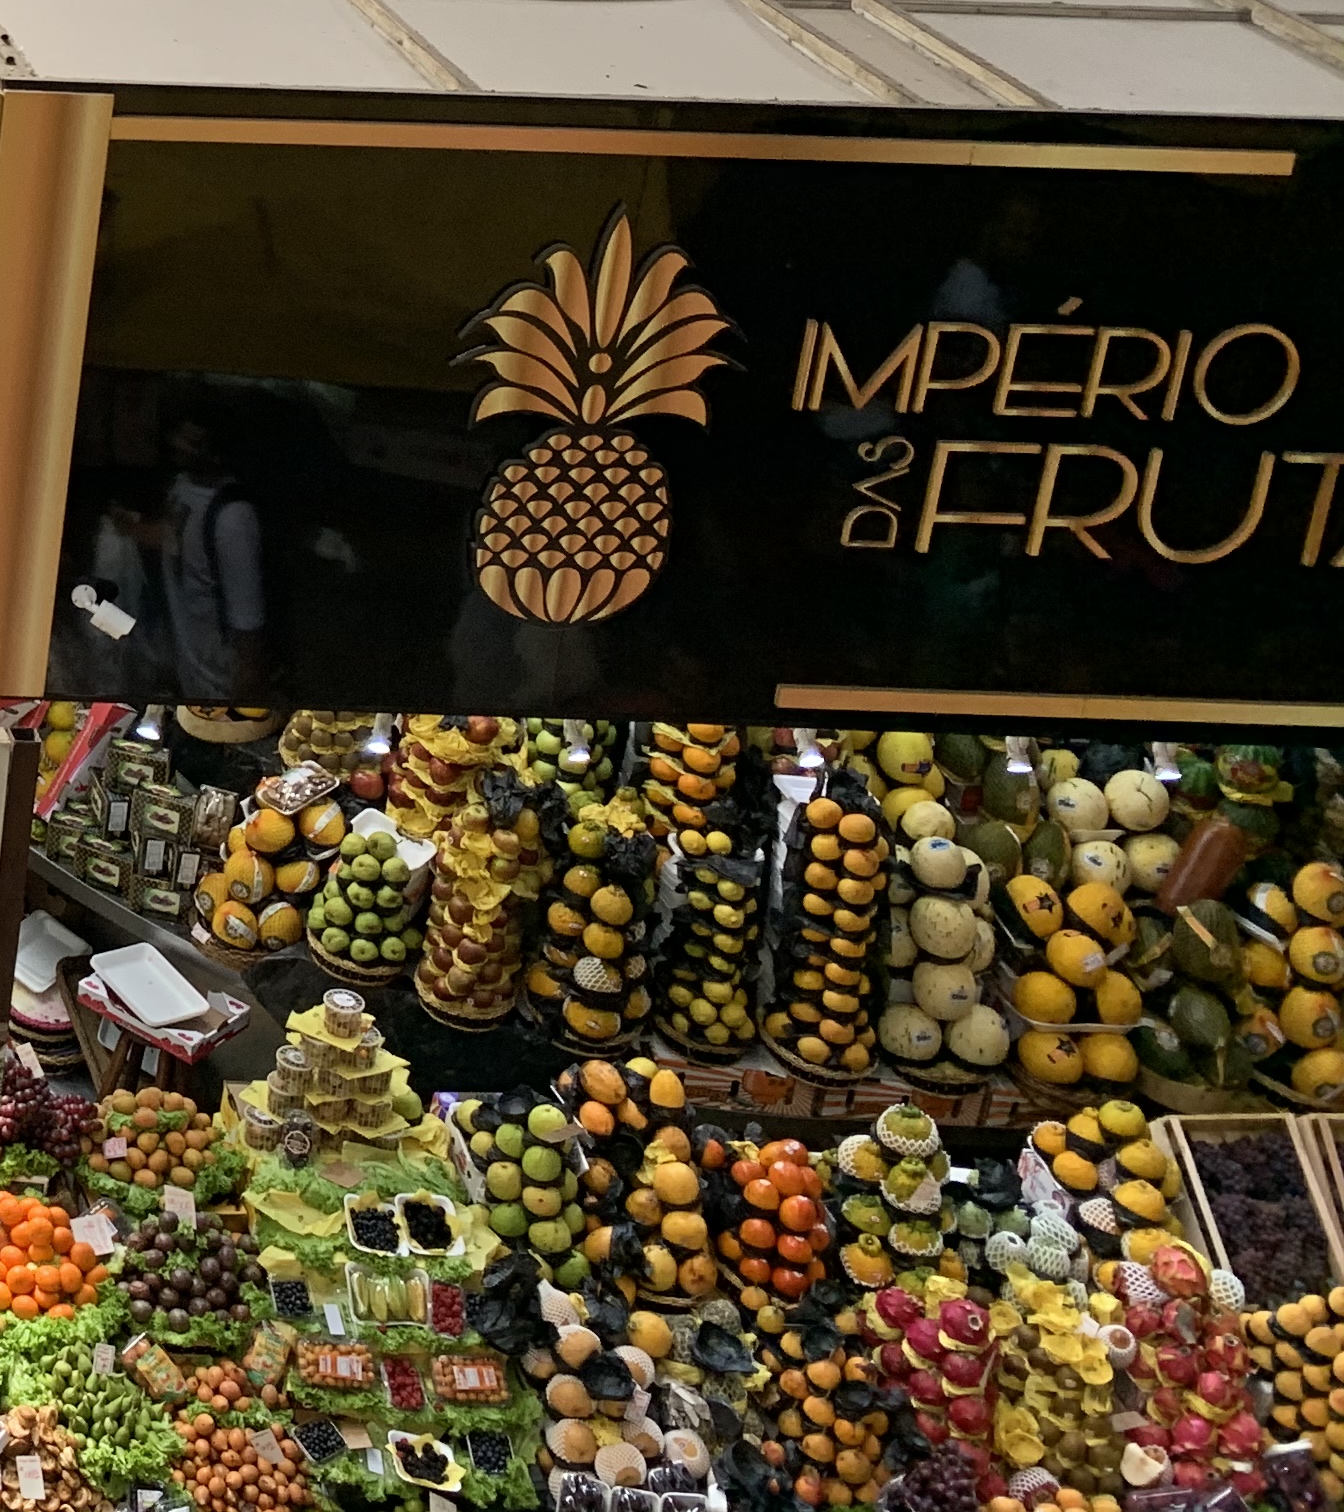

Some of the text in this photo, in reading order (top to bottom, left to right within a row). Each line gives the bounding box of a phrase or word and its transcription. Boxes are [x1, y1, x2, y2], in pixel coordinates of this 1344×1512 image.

[792, 296, 1301, 426] IMPÉRIO
[841, 436, 915, 549] DAS
[914, 439, 1344, 568] FRUT
